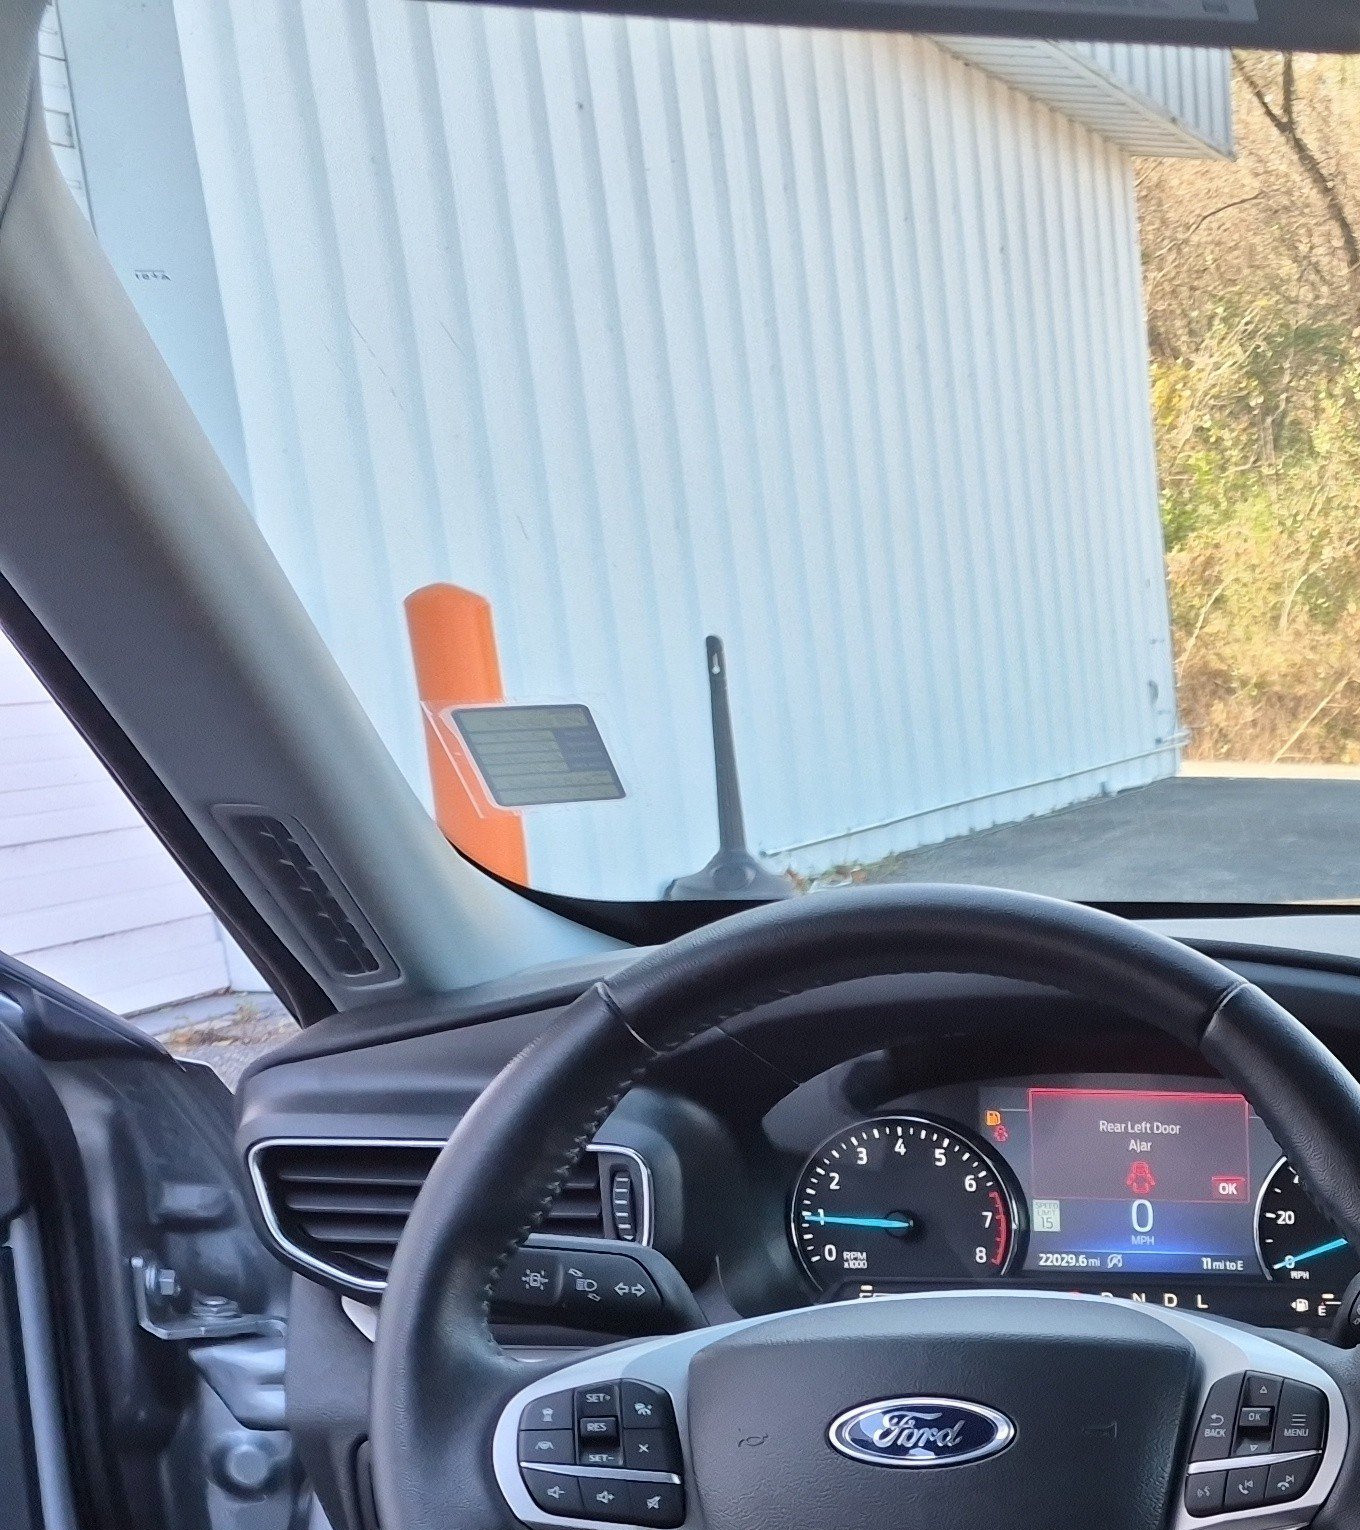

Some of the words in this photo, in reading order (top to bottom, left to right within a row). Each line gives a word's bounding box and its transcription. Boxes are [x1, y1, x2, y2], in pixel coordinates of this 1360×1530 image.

[1099, 1120, 1126, 1133] Rear
[1128, 1121, 1151, 1134] Left
[1153, 1121, 1181, 1135] Door
[894, 1138, 906, 1156] 4
[1129, 1139, 1152, 1153] Ajar
[856, 1147, 868, 1165] 3
[934, 1148, 947, 1166] 5
[829, 1173, 841, 1190] 2
[964, 1175, 977, 1192] 6
[1218, 1182, 1238, 1195] OK
[981, 1211, 993, 1228] 7
[1041, 1216, 1054, 1229] 15
[1131, 1199, 1154, 1233] 0
[1276, 1211, 1295, 1225] 20
[1131, 1235, 1155, 1246] MPH
[824, 1244, 837, 1261] 0
[843, 1252, 867, 1261] RPM
[975, 1247, 987, 1264] 8
[843, 1260, 868, 1269] x1000
[1038, 1253, 1087, 1267] 22029.6
[1201, 1256, 1212, 1270] 11
[1225, 1260, 1237, 1271] to
[1236, 1260, 1244, 1271] E
[1290, 1271, 1309, 1280] MPH
[1163, 1292, 1178, 1308] D
[1196, 1294, 1209, 1309] L
[1317, 1305, 1326, 1316] E
[585, 1393, 611, 1403] SET+
[1248, 1413, 1261, 1421] OK
[586, 1422, 607, 1431] RES
[873, 1411, 963, 1448] Ford
[1204, 1428, 1226, 1438] BACK
[1283, 1428, 1309, 1437] MENU
